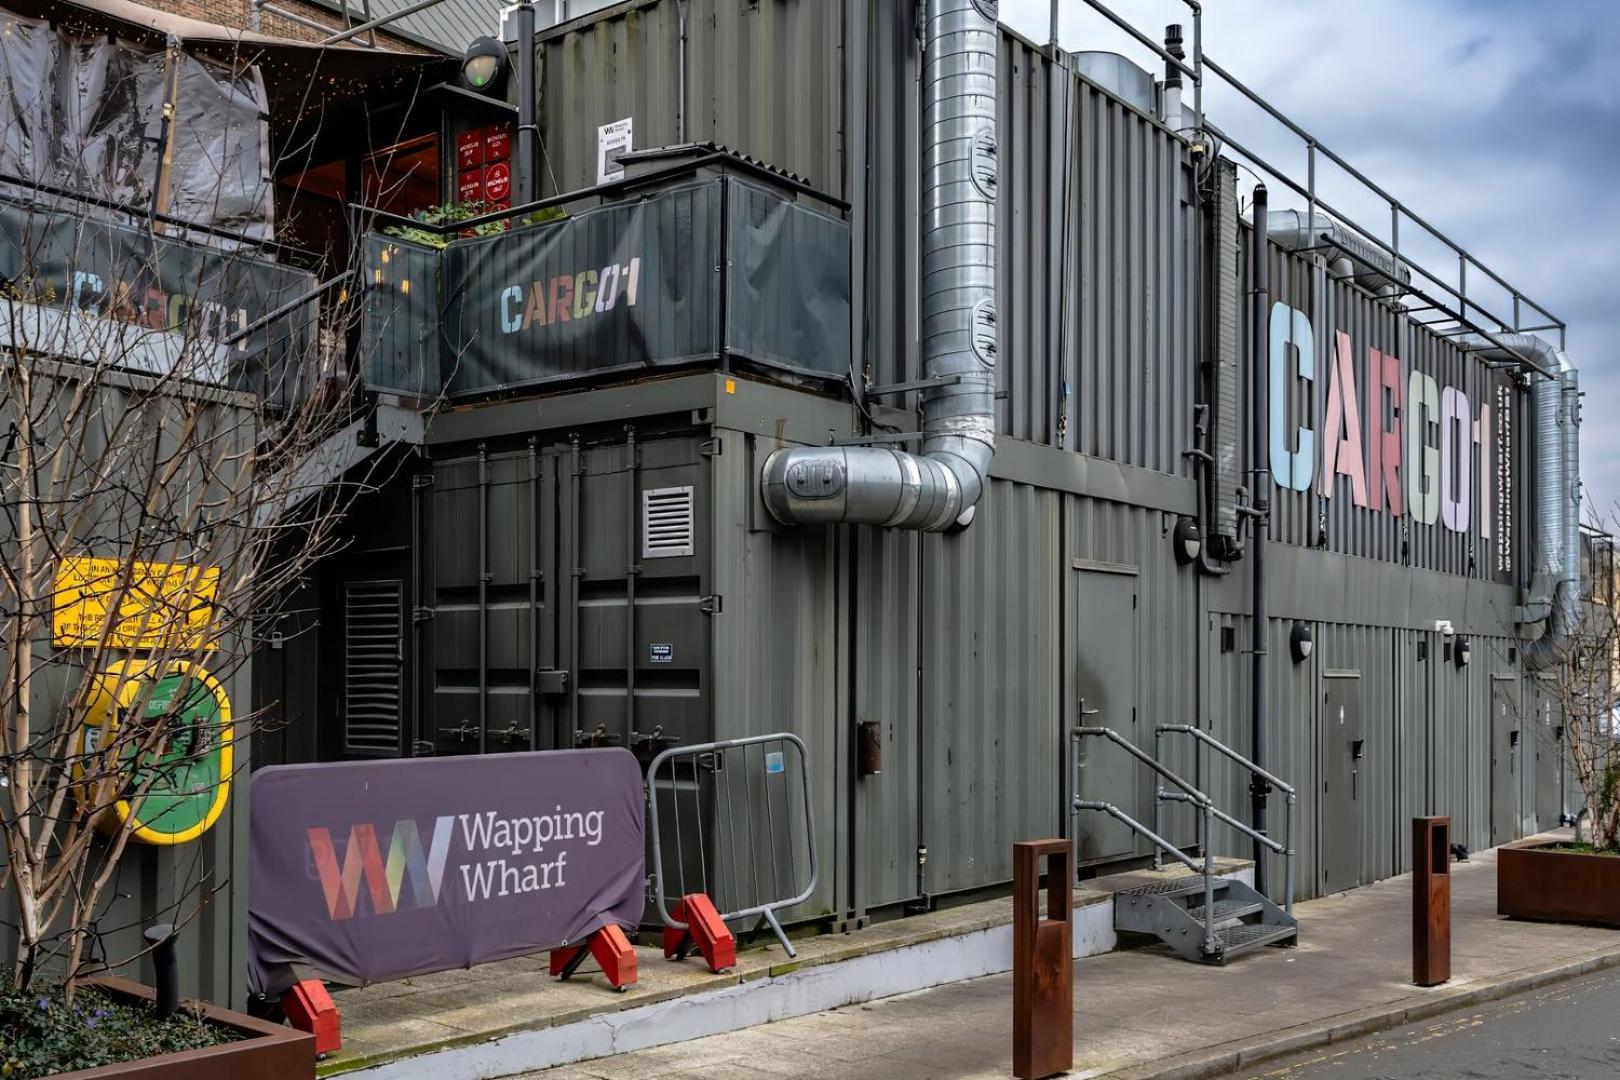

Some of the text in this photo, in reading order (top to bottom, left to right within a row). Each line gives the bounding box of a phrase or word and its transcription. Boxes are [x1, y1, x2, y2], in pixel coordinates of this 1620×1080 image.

[501, 257, 640, 334] CARGO1
[1269, 301, 1491, 539] CARGO1
[459, 805, 605, 855] Wapping
[460, 851, 567, 902] Wharf
